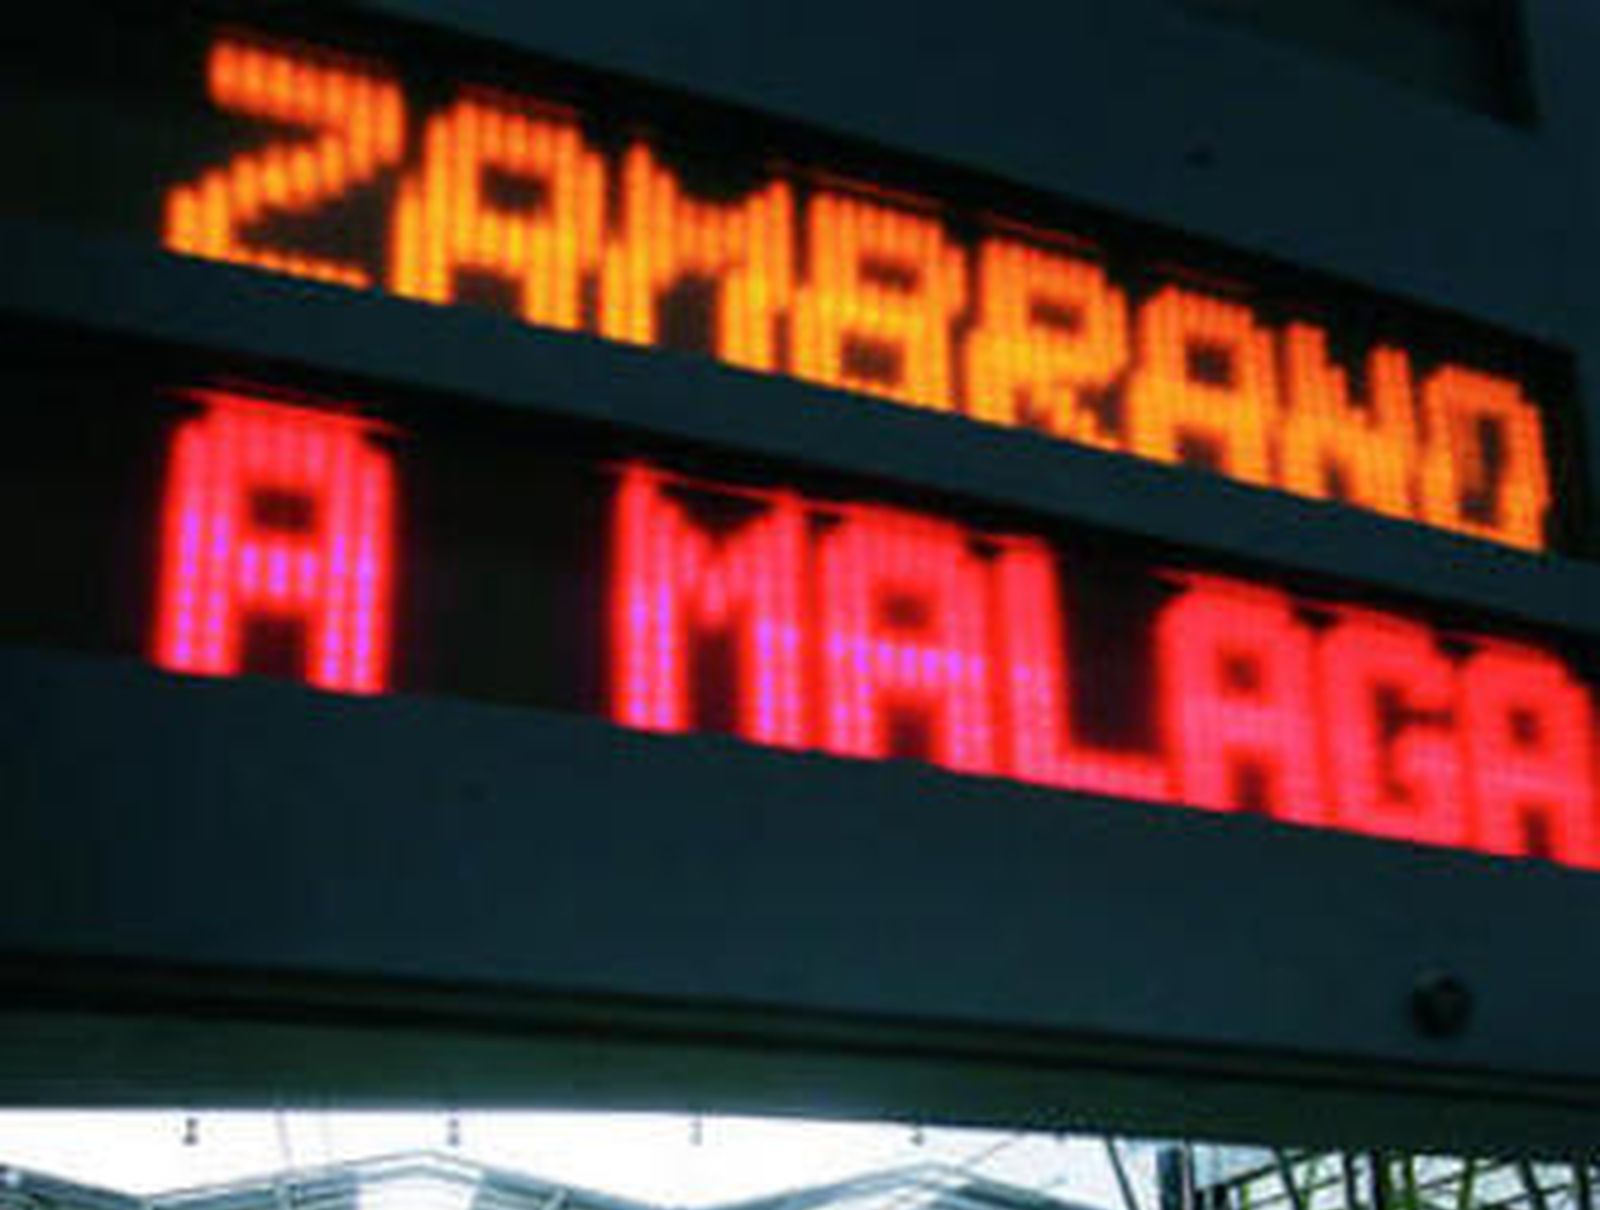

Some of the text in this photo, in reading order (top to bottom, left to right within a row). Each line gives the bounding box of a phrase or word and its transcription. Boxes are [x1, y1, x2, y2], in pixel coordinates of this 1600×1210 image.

[164, 40, 1551, 551] ZAMBRANO
[152, 396, 1600, 871] A MALAGA
